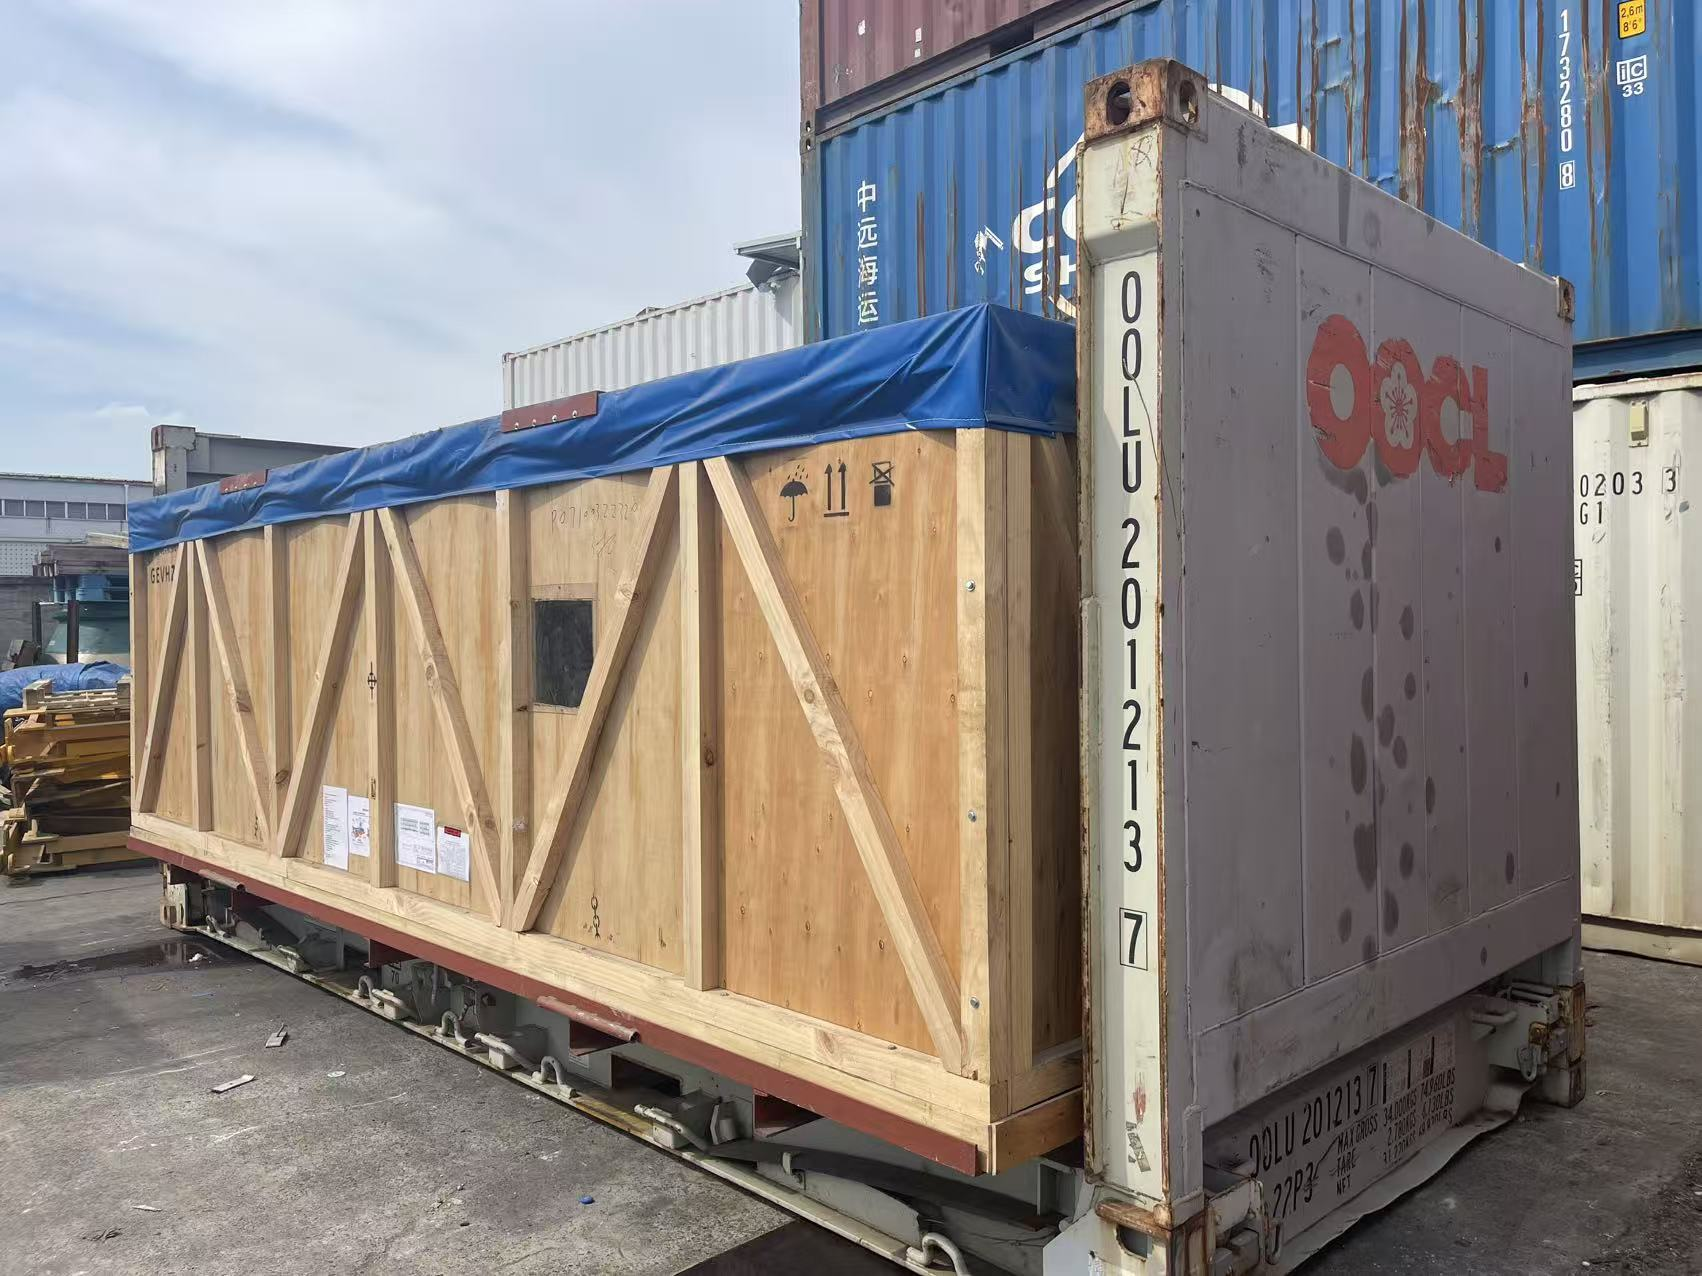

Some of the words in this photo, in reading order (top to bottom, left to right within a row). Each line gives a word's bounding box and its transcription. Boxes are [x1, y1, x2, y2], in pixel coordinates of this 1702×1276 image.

[1558, 9, 1573, 153] 173280
[1622, 82, 1644, 98] 33
[1560, 162, 1574, 188] 8
[1120, 270, 1142, 494] OOLU
[1306, 313, 1508, 493] OOCL
[1120, 517, 1142, 874] 201213
[1121, 910, 1145, 967] 7
[1301, 1074, 1362, 1147] 201213
[1367, 1062, 1379, 1107] 7
[1336, 1148, 1357, 1178] TARE
